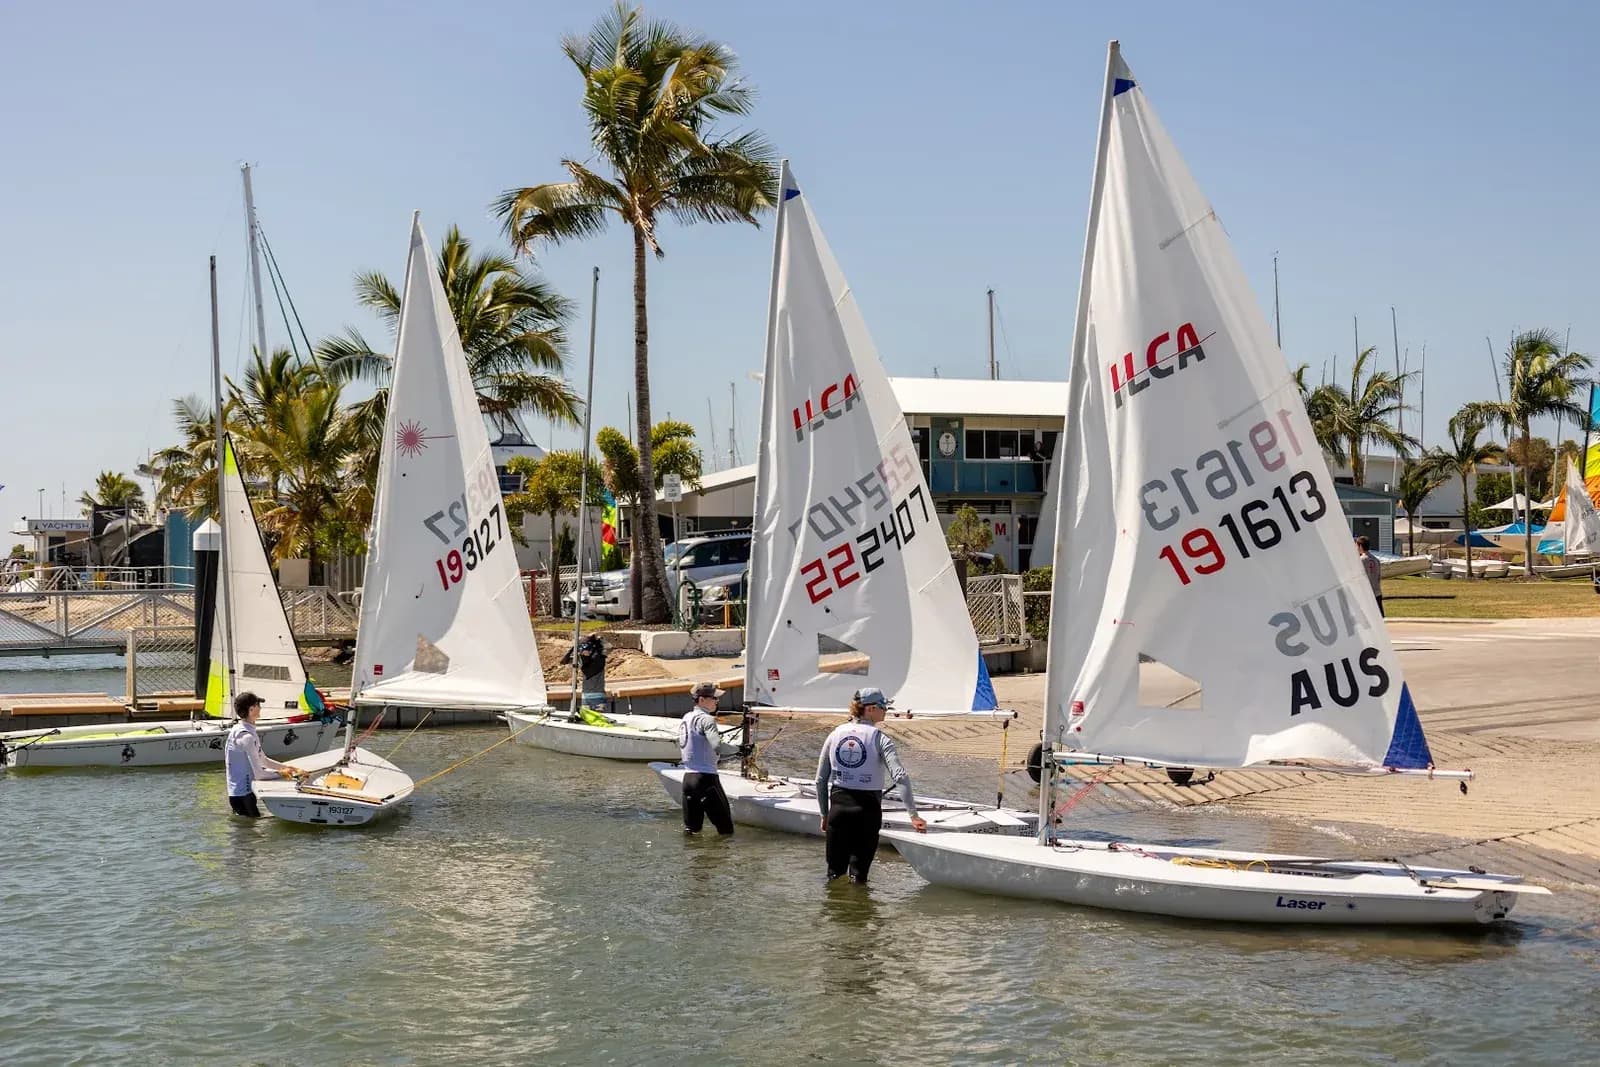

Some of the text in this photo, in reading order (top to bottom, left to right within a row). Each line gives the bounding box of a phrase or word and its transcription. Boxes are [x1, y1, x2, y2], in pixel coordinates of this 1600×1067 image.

[1110, 322, 1208, 410] ILCA
[792, 372, 862, 443] ILCA
[435, 502, 504, 593] 193127
[800, 483, 930, 605] 222407
[994, 522, 1007, 536] M
[1158, 470, 1328, 587] 191613
[1290, 646, 1390, 716] AUS
[328, 805, 354, 815] 193127
[1275, 895, 1327, 911] Laser
